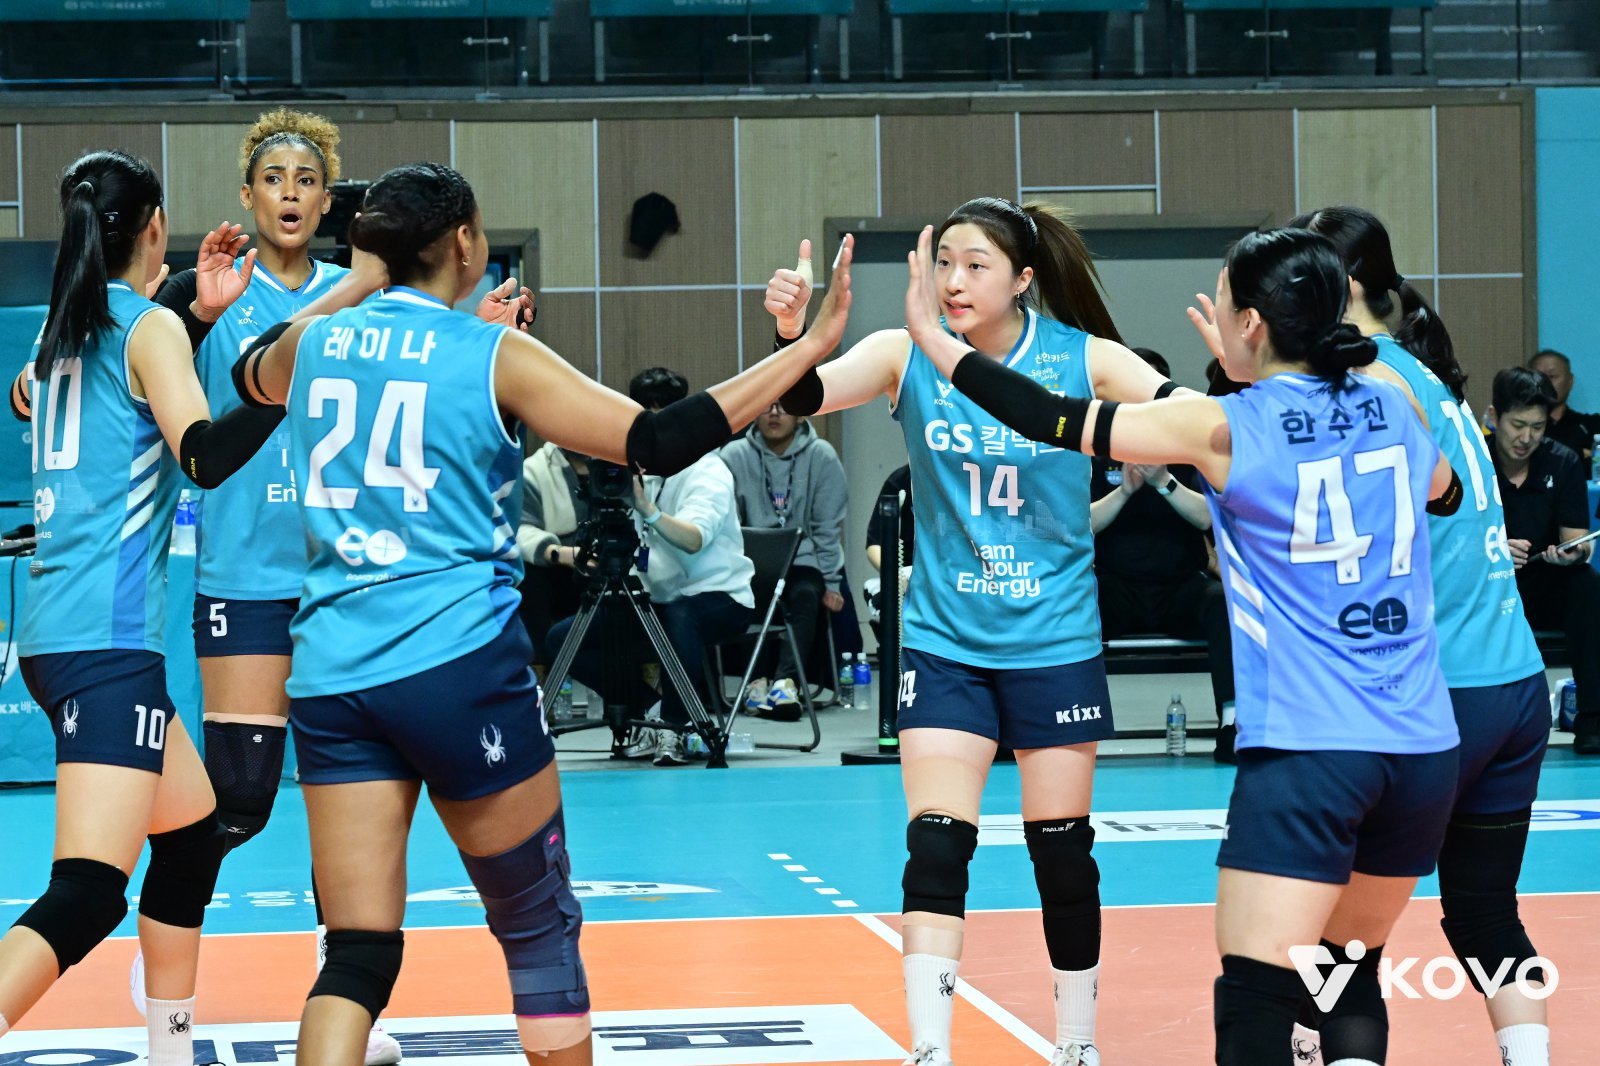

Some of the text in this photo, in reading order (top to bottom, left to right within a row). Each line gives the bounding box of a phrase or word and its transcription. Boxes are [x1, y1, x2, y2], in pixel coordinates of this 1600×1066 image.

[323, 326, 437, 365] 레이나
[1034, 351, 1070, 365] 신한카드
[934, 398, 954, 409] KOVO
[1279, 396, 1389, 445] 한수진
[304, 377, 441, 513] 24
[924, 419, 974, 454] GS
[962, 461, 1025, 517] 14
[1289, 444, 1416, 586] 47
[980, 544, 1015, 560] am
[957, 571, 1041, 599] Energy
[982, 560, 1035, 581] your
[209, 602, 229, 638] 5
[135, 704, 166, 751] 10
